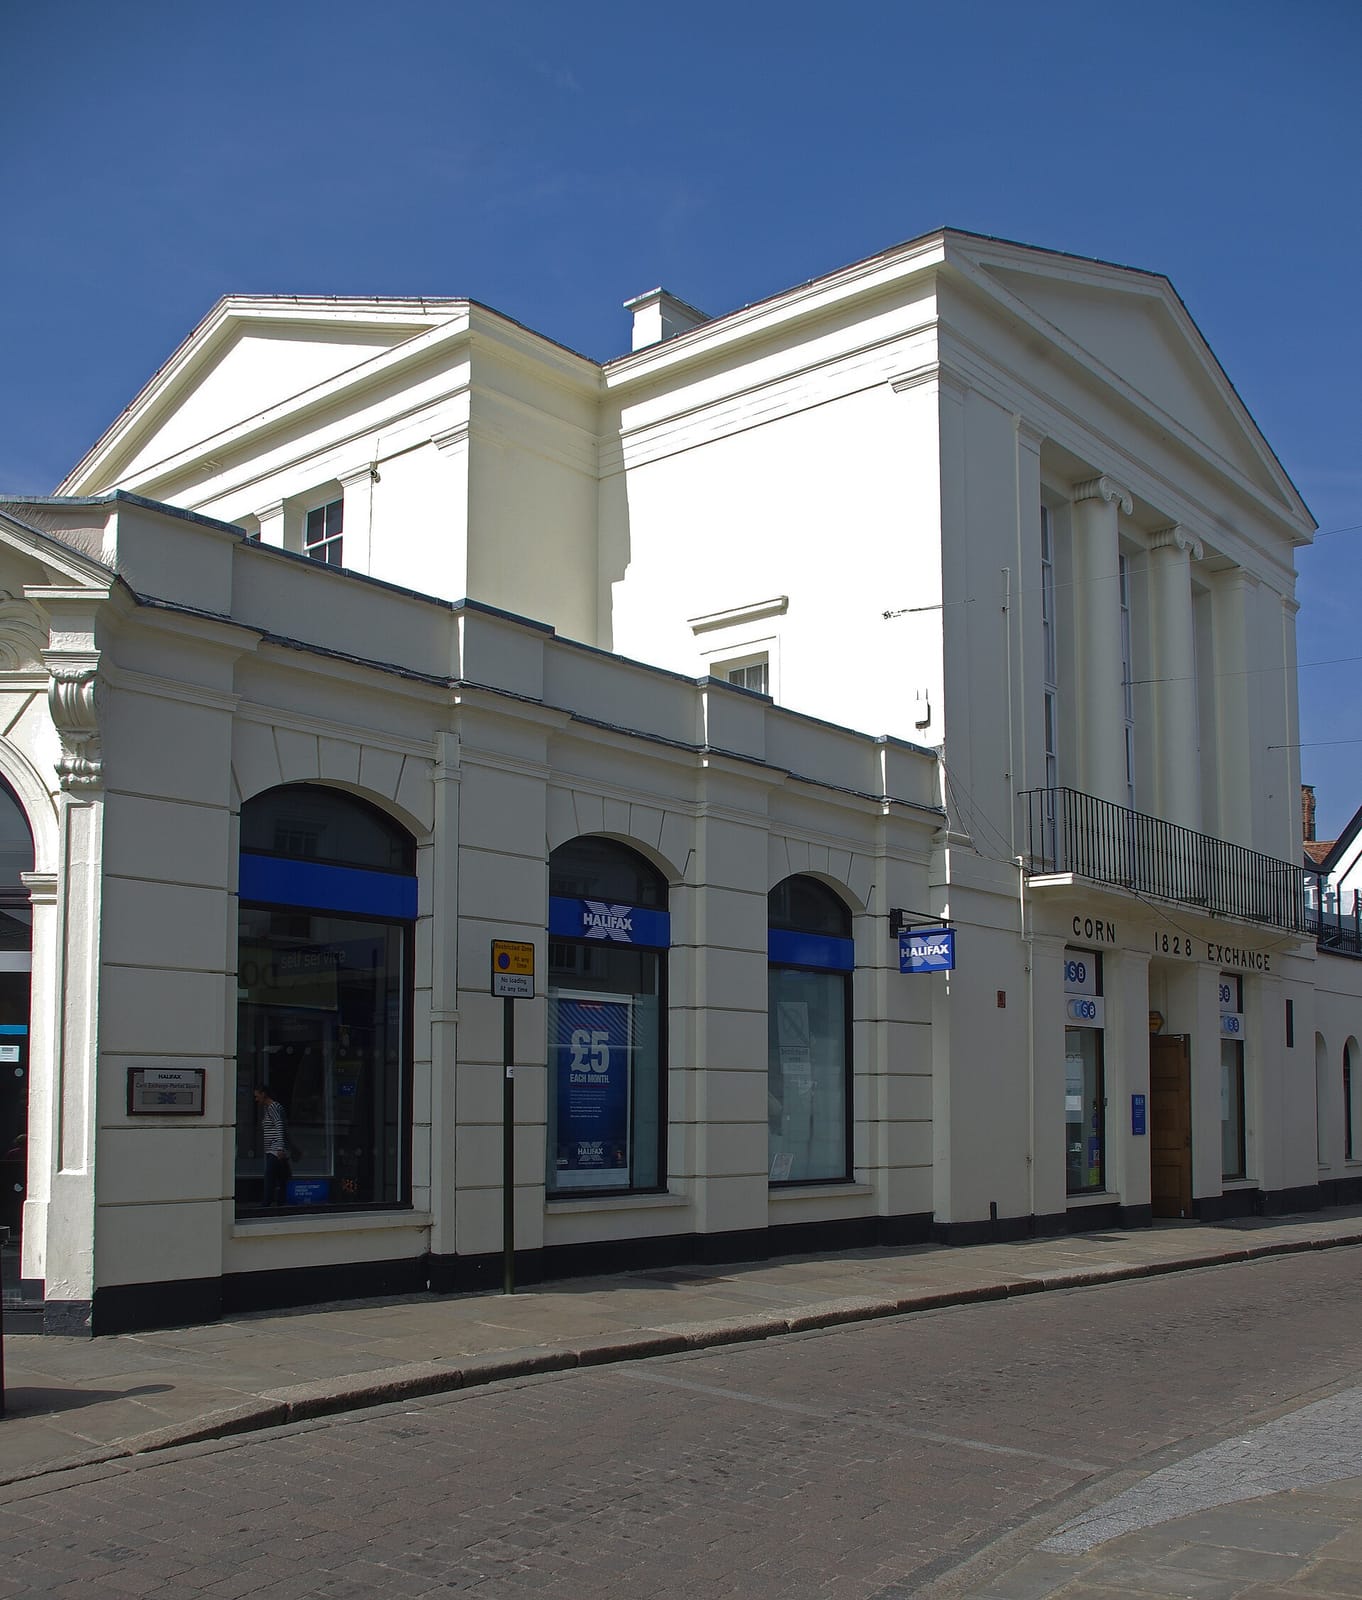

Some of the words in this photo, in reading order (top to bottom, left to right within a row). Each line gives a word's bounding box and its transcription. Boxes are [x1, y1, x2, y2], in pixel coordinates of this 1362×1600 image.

[583, 912, 633, 931] HALIFAX
[1072, 915, 1116, 943] CORN
[900, 944, 949, 958] HALIFAX
[1154, 931, 1192, 957] 1828
[1207, 943, 1270, 971] EXCHANGE
[509, 977, 527, 985] loading
[570, 1029, 610, 1073] £5
[570, 1073, 588, 1083] EACH
[577, 1147, 604, 1156] HALIFAX
